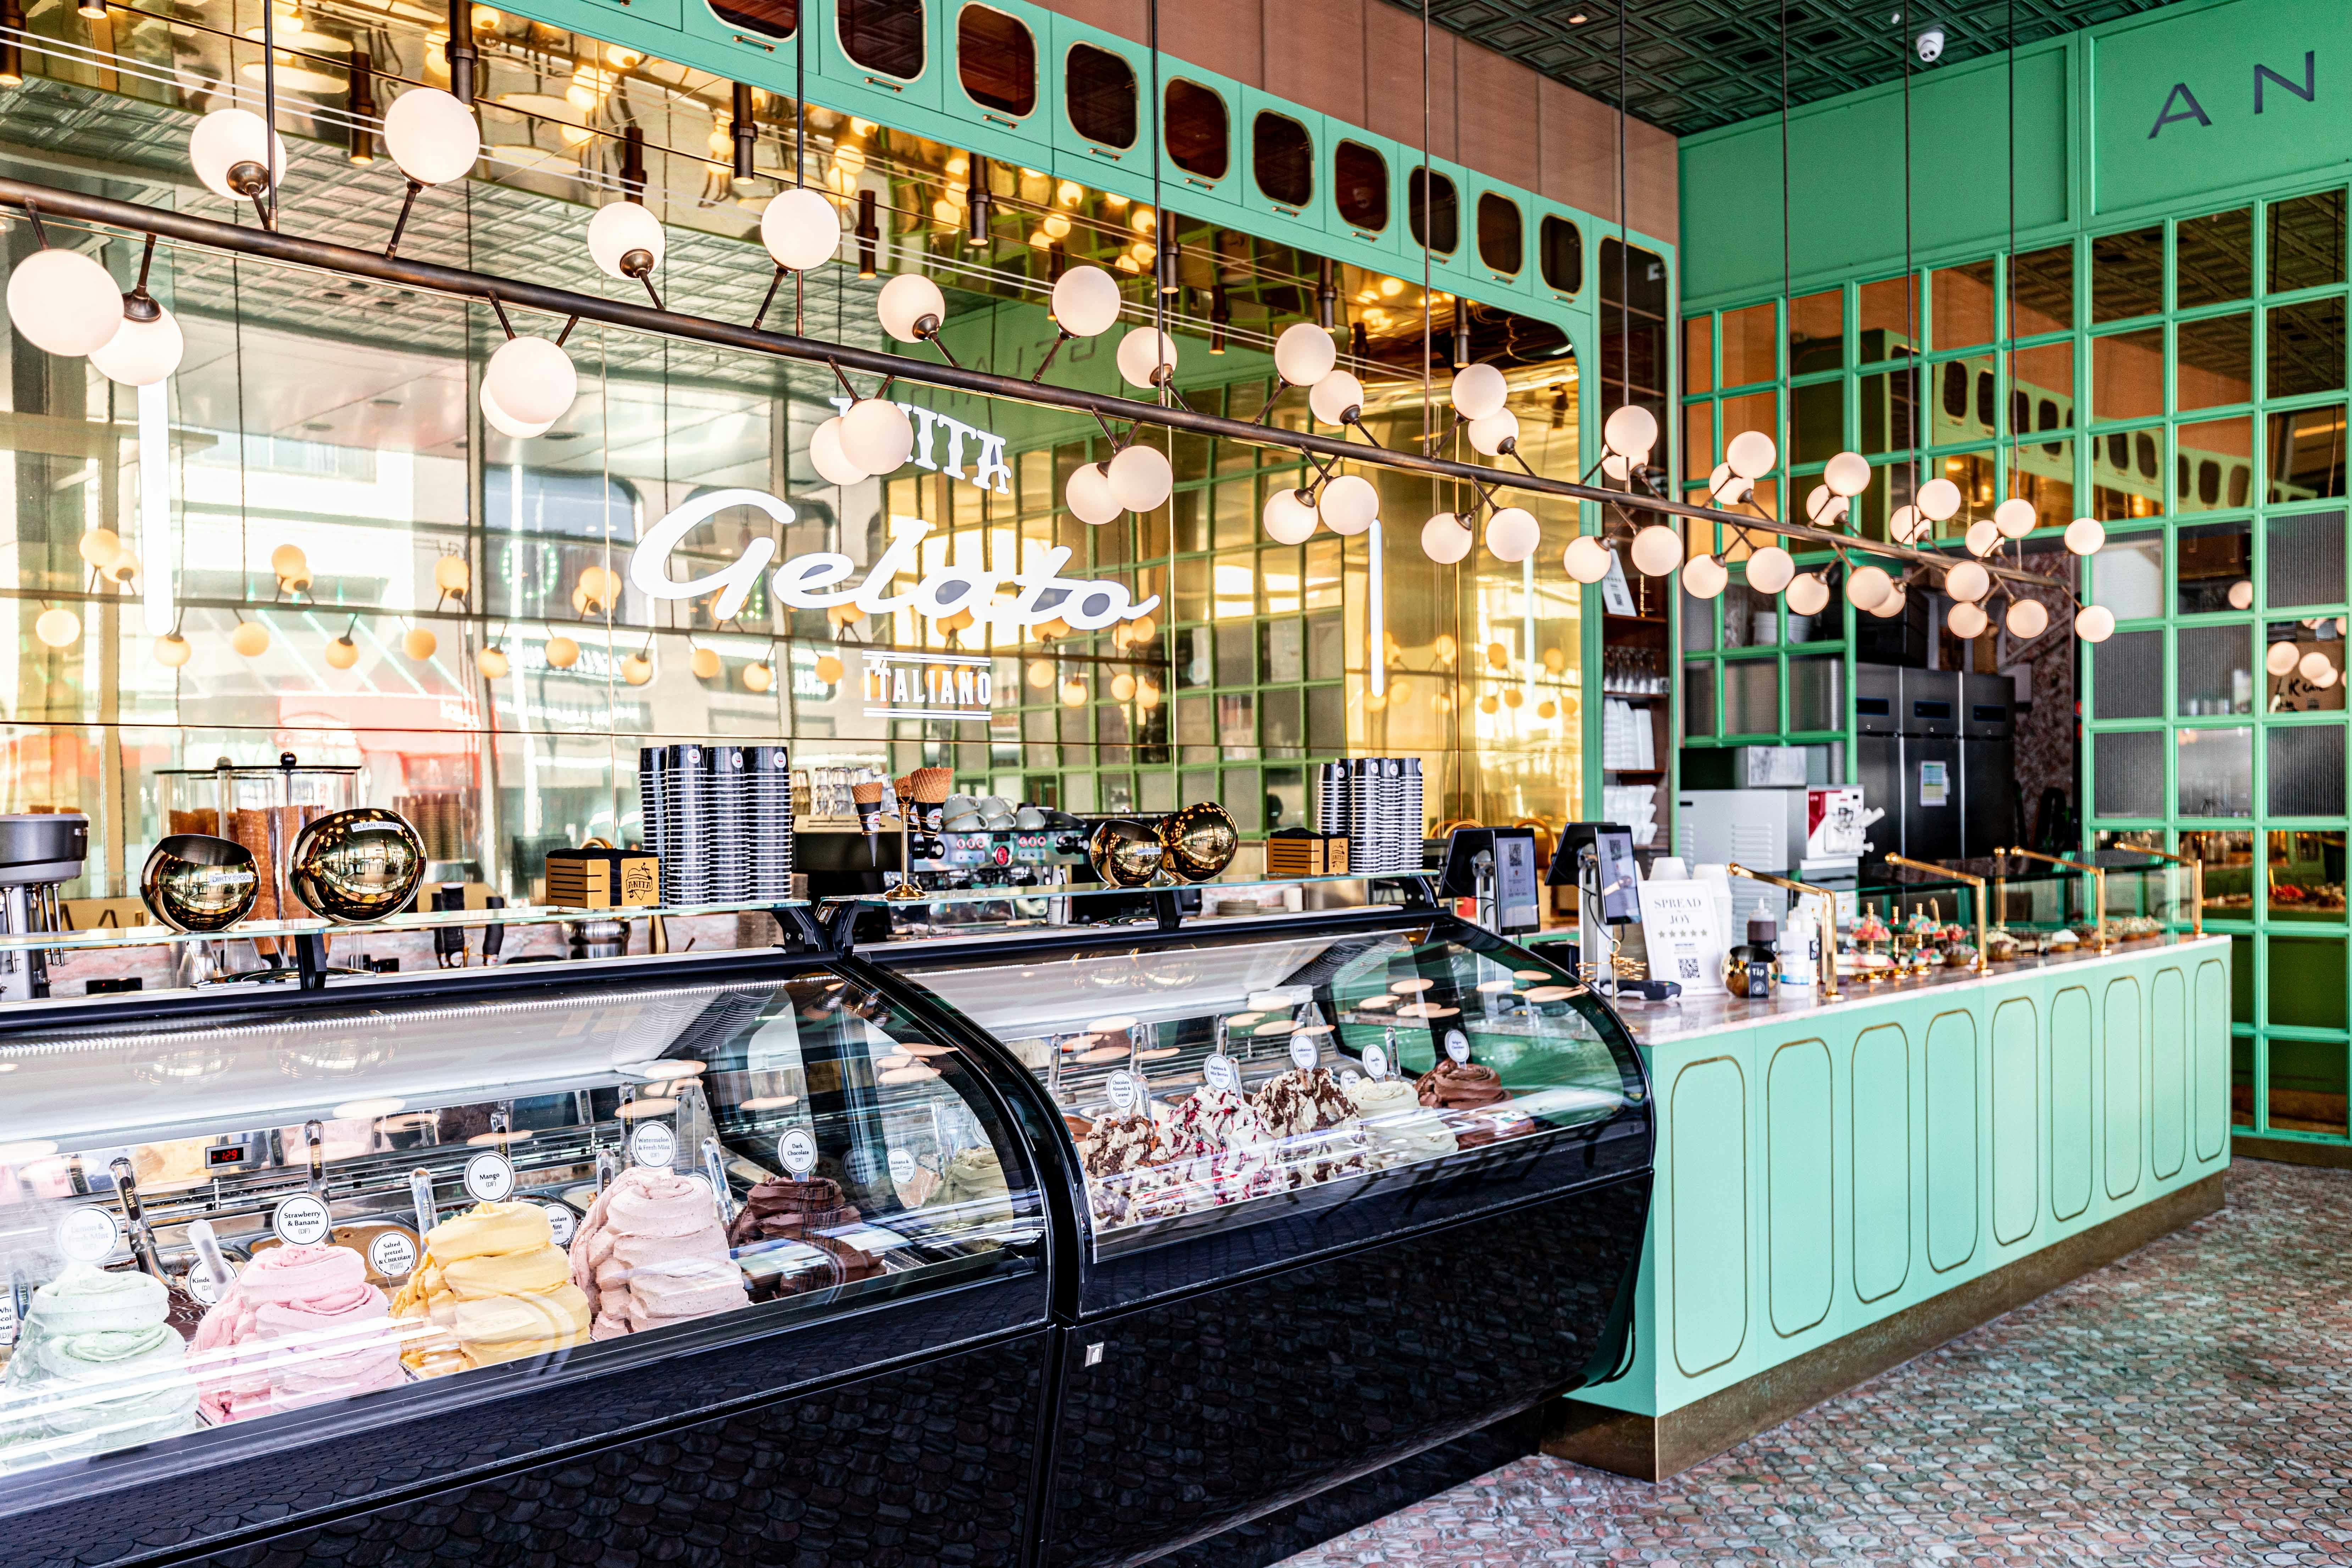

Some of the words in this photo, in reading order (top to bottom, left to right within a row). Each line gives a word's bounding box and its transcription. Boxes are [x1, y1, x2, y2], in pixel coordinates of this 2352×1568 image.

[2148, 51, 2314, 139] AN
[829, 397, 1012, 494] ITA
[630, 489, 1161, 630] Gelato
[863, 666, 991, 705] ITALIANO
[628, 880, 651, 889] ANITA
[1654, 897, 1701, 908] SPREAD
[1669, 914, 1690, 924] JOY
[1752, 967, 1765, 977] Tip
[125, 1187, 137, 1209] ANITA
[383, 1240, 401, 1249] Salted
[384, 1248, 403, 1258] pretzel
